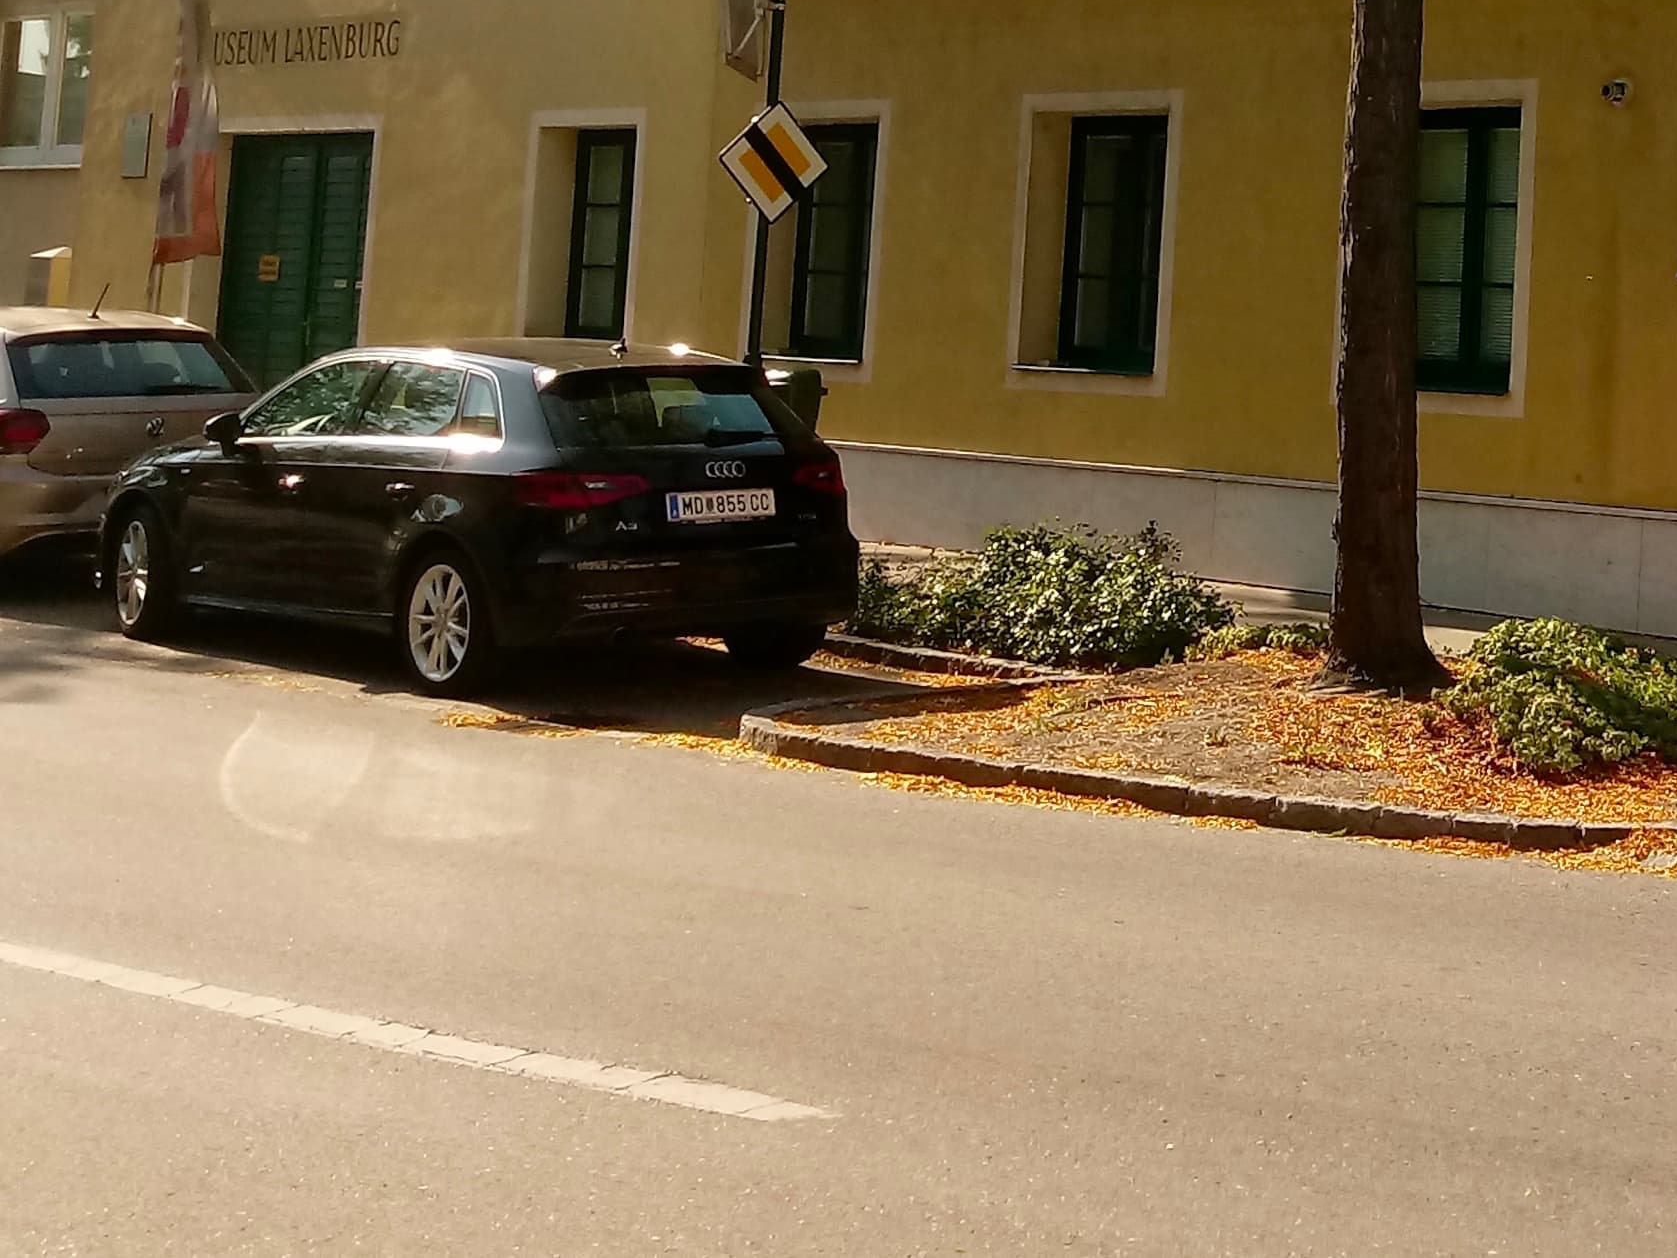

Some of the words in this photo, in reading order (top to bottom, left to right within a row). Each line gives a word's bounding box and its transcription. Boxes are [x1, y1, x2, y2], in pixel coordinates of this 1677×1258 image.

[212, 29, 277, 66] USEUM
[284, 20, 401, 64] LAXENBURG
[682, 495, 704, 516] MD
[716, 494, 746, 514] 855
[751, 493, 769, 511] CC
